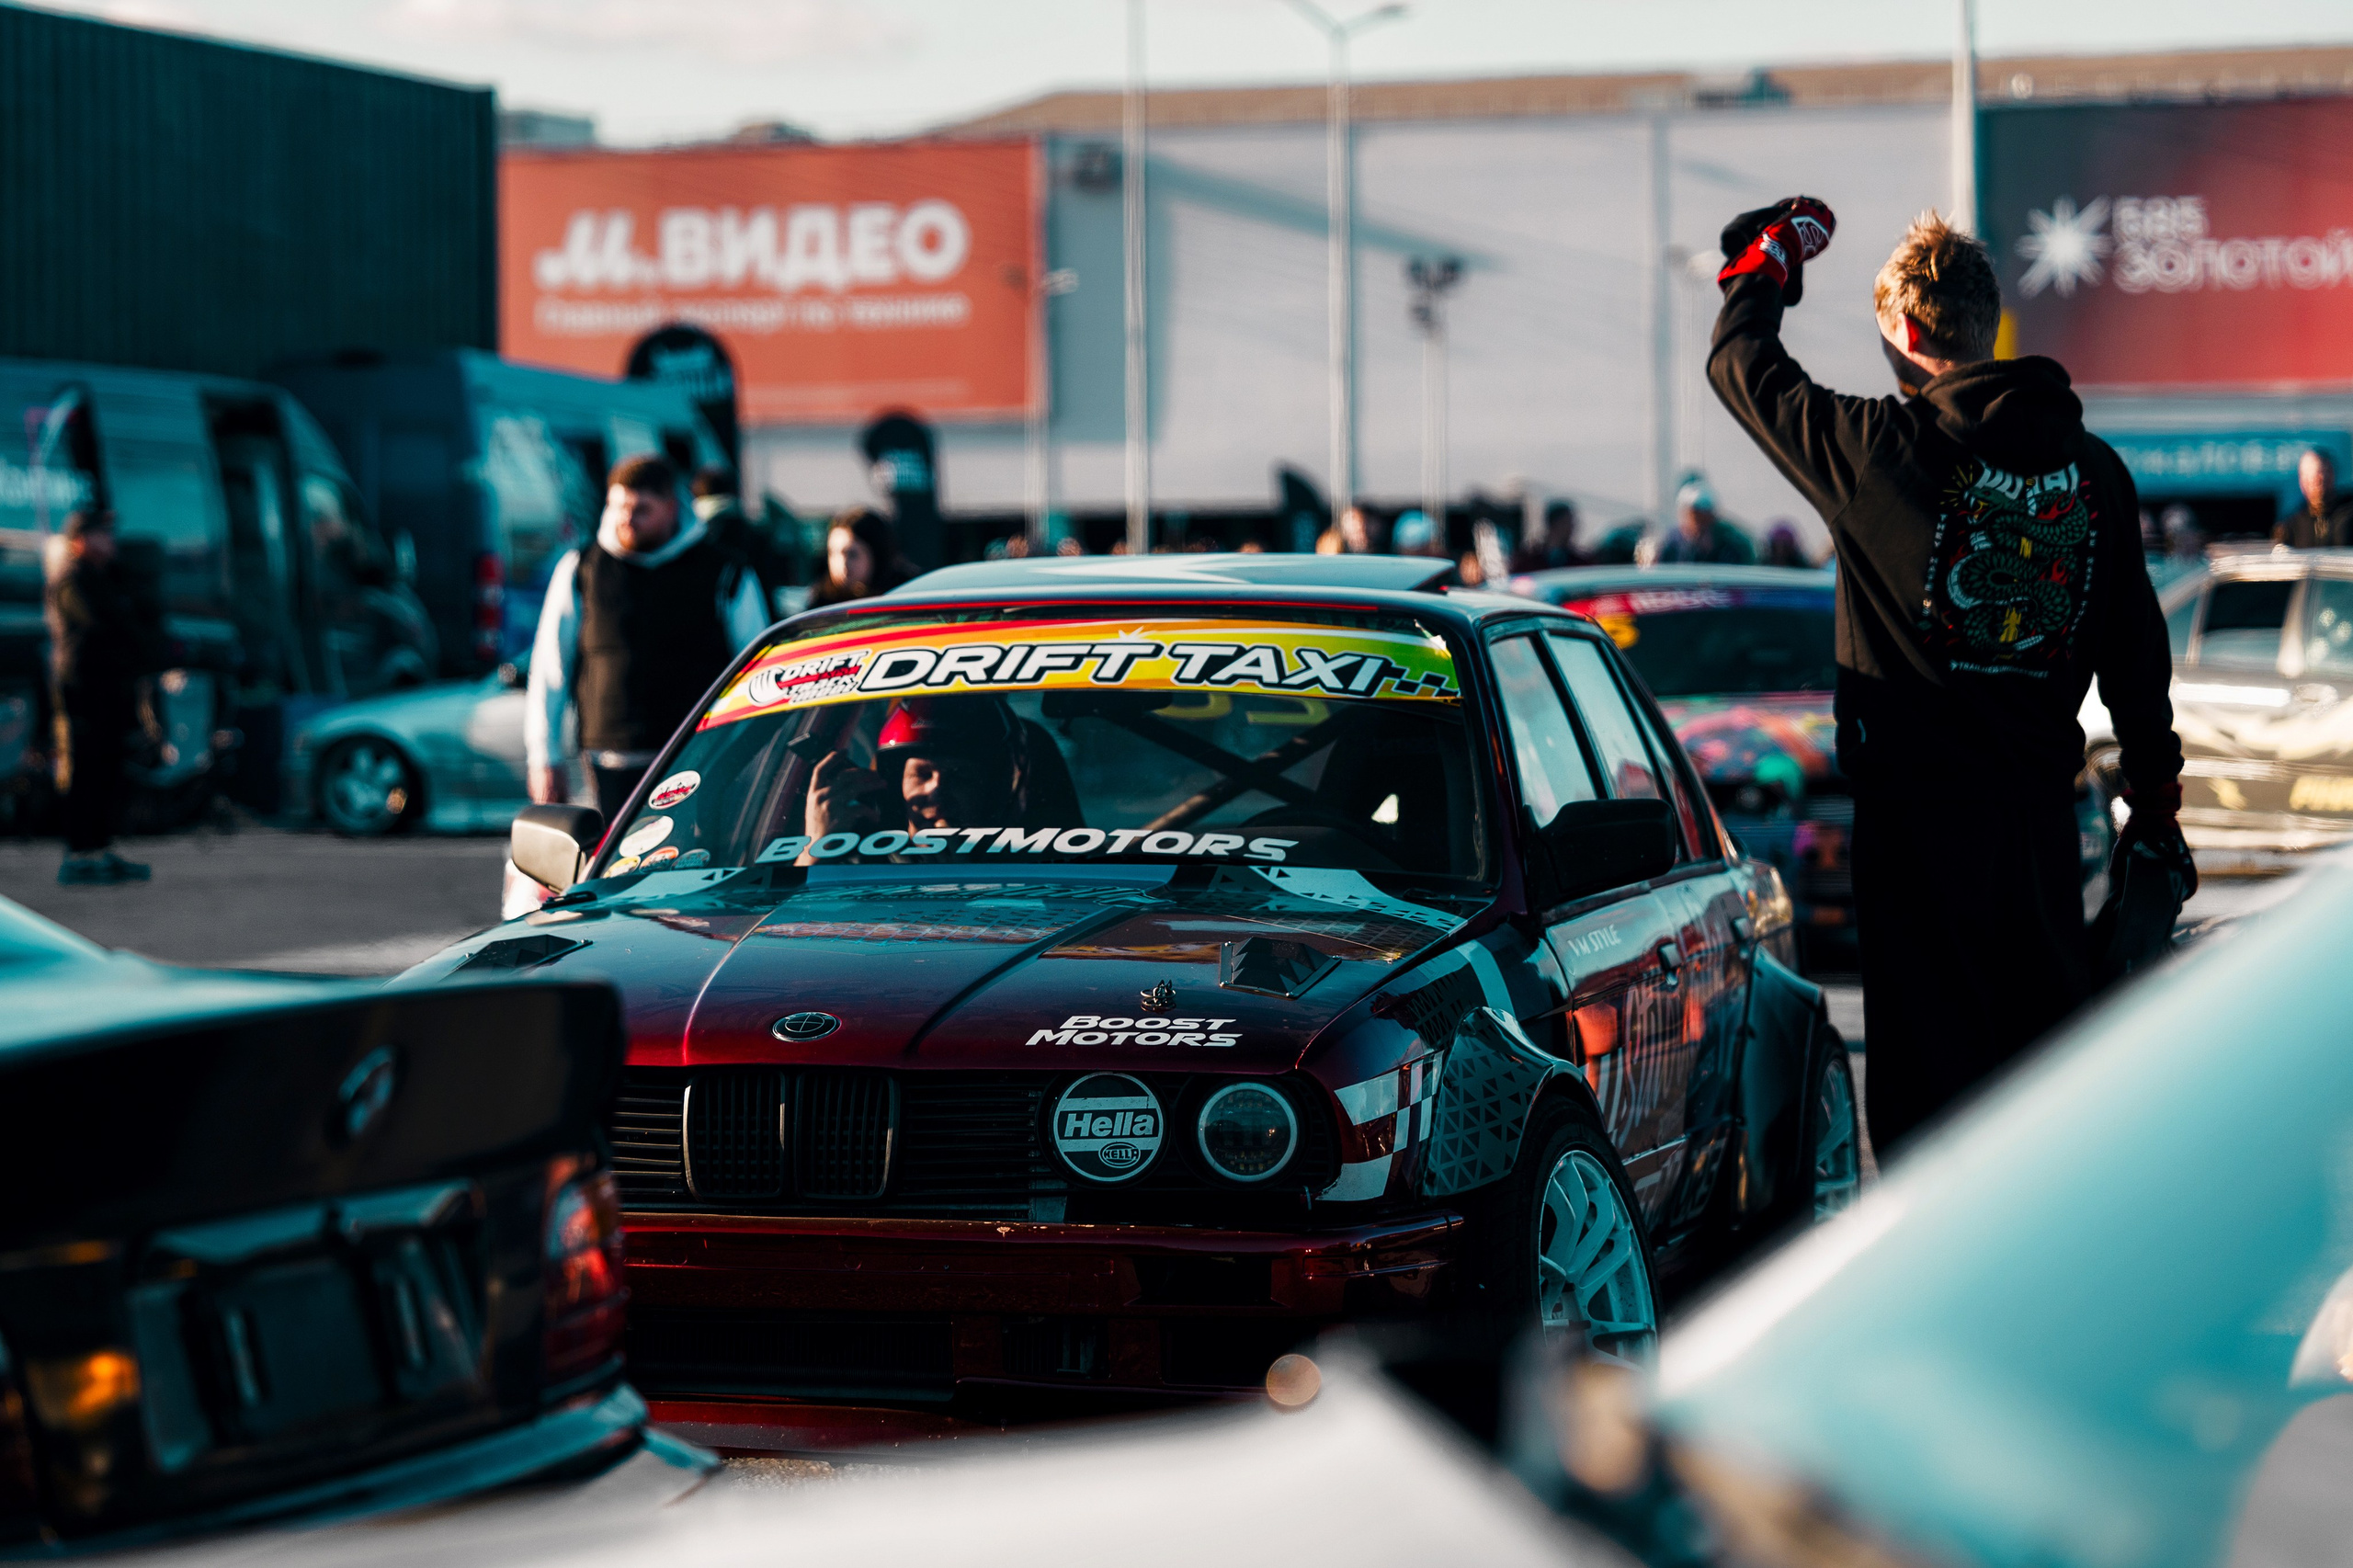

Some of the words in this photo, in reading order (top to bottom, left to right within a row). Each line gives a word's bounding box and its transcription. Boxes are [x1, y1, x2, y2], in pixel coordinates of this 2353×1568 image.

[779, 651, 869, 682] DRIFT
[858, 642, 1163, 691] DRIFT
[1170, 643, 1390, 697] TAXI
[755, 827, 1299, 864] BOOSTMOTORS
[1587, 924, 1621, 952] STYLE
[1060, 1015, 1237, 1030] BOOST
[1025, 1029, 1243, 1047] MOTORS
[1063, 1111, 1154, 1138] Hella
[1104, 1149, 1140, 1160] HELLA
